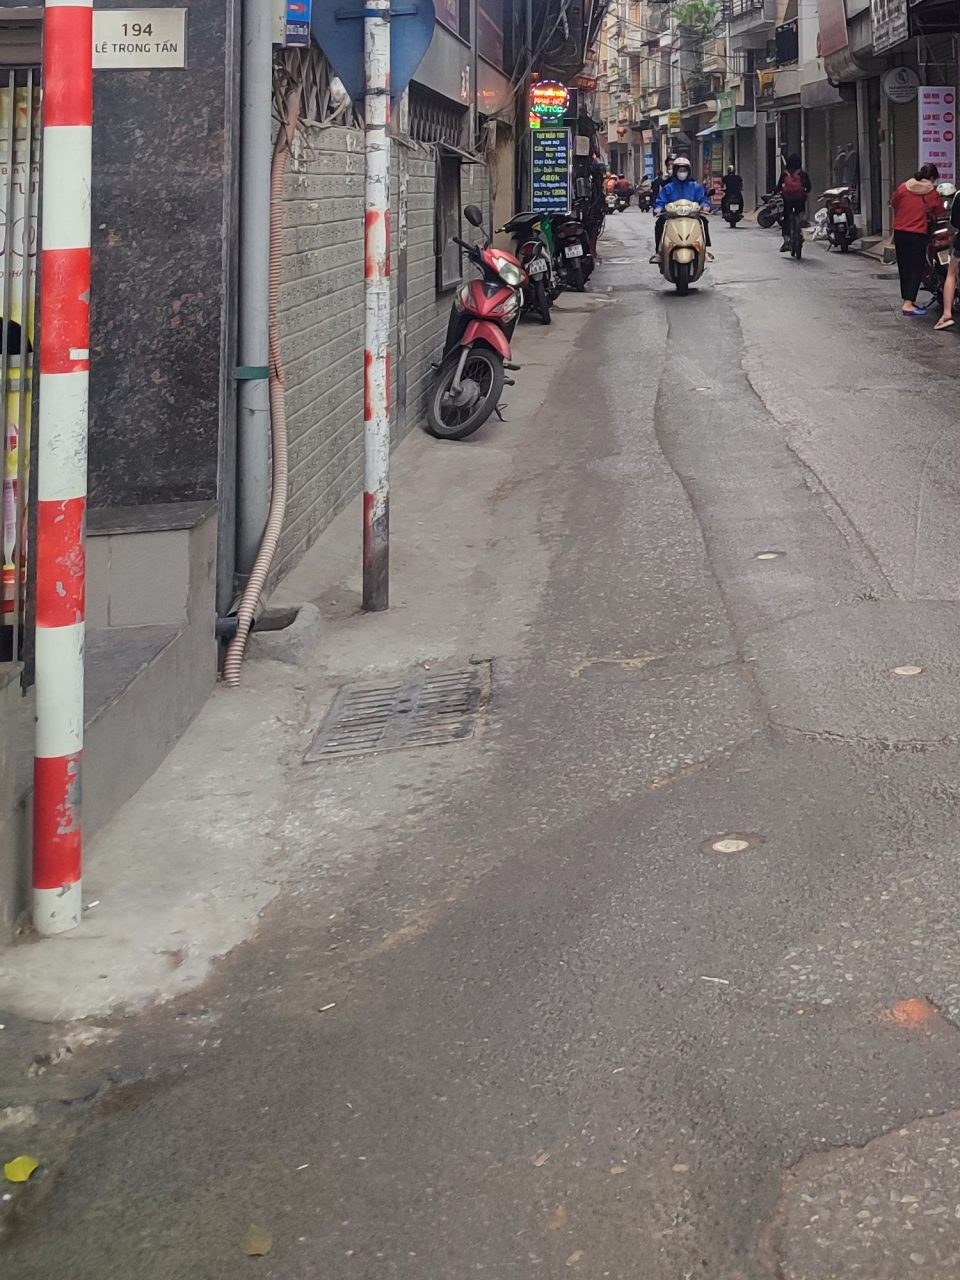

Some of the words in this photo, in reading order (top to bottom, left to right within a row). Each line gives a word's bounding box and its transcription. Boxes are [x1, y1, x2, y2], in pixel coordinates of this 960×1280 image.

[121, 23, 153, 37] 194
[95, 40, 108, 53] LÊ
[112, 42, 151, 56] TRỌNG
[155, 38, 178, 53] TẤN
